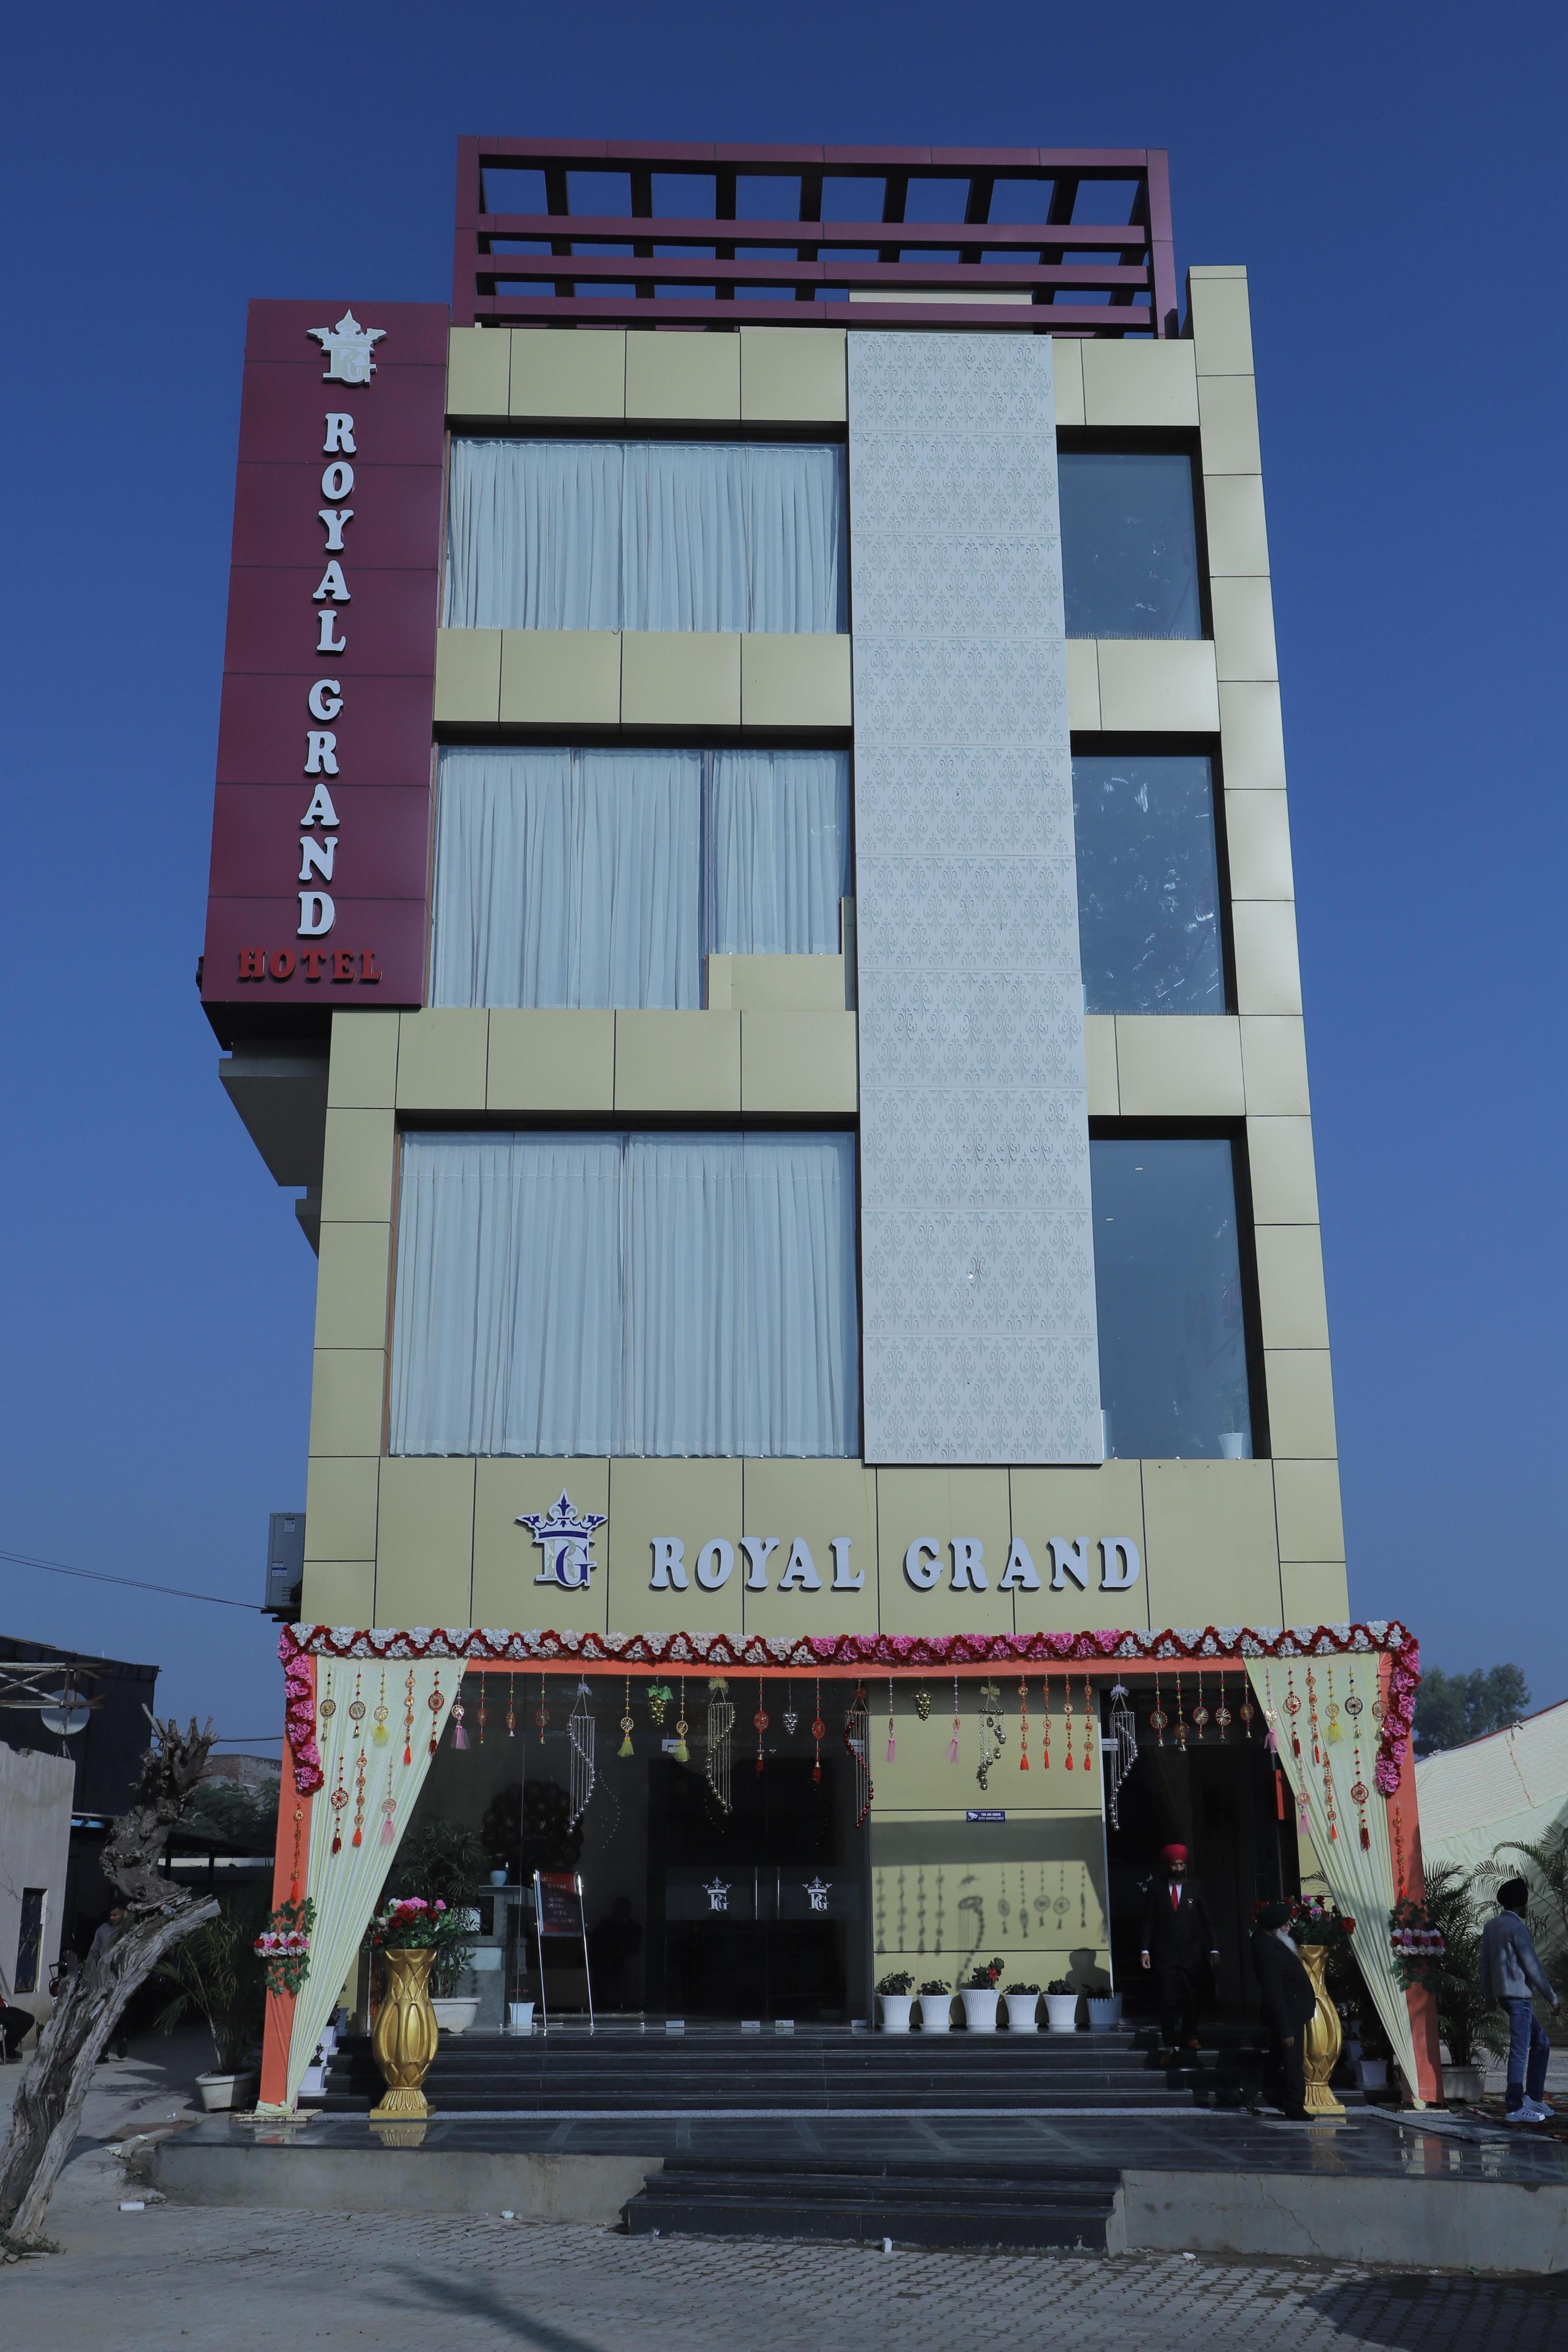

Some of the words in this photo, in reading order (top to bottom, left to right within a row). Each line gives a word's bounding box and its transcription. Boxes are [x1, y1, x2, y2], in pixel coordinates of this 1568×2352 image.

[312, 412, 357, 652] ROYAL
[297, 678, 344, 936] GRAND
[238, 947, 383, 983] HOTEL
[650, 1536, 866, 1589] ROYAL
[904, 1536, 1140, 1589] GRAND
